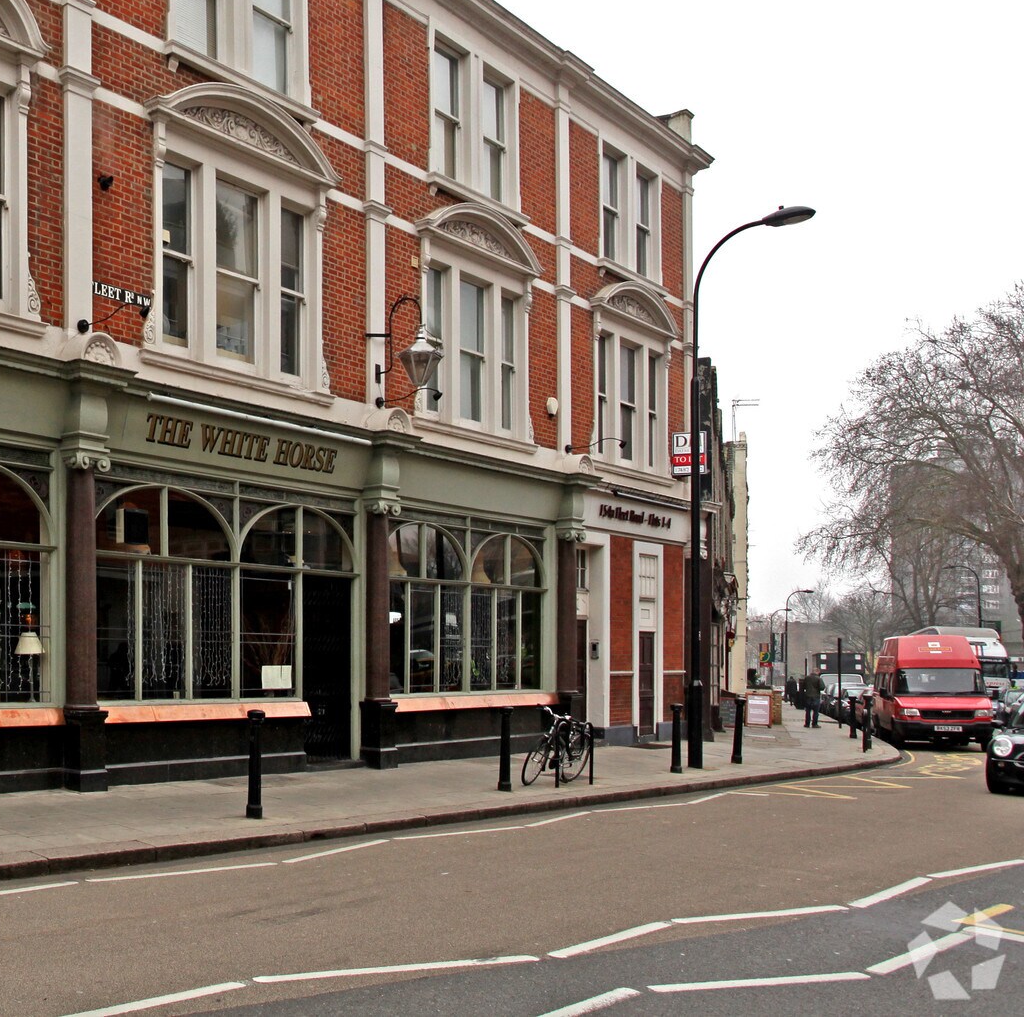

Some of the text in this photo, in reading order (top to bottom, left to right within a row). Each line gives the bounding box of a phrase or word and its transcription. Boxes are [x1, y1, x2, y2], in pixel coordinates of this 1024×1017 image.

[92, 281, 122, 301] LEET
[145, 412, 338, 474] THE WHITE HORSE
